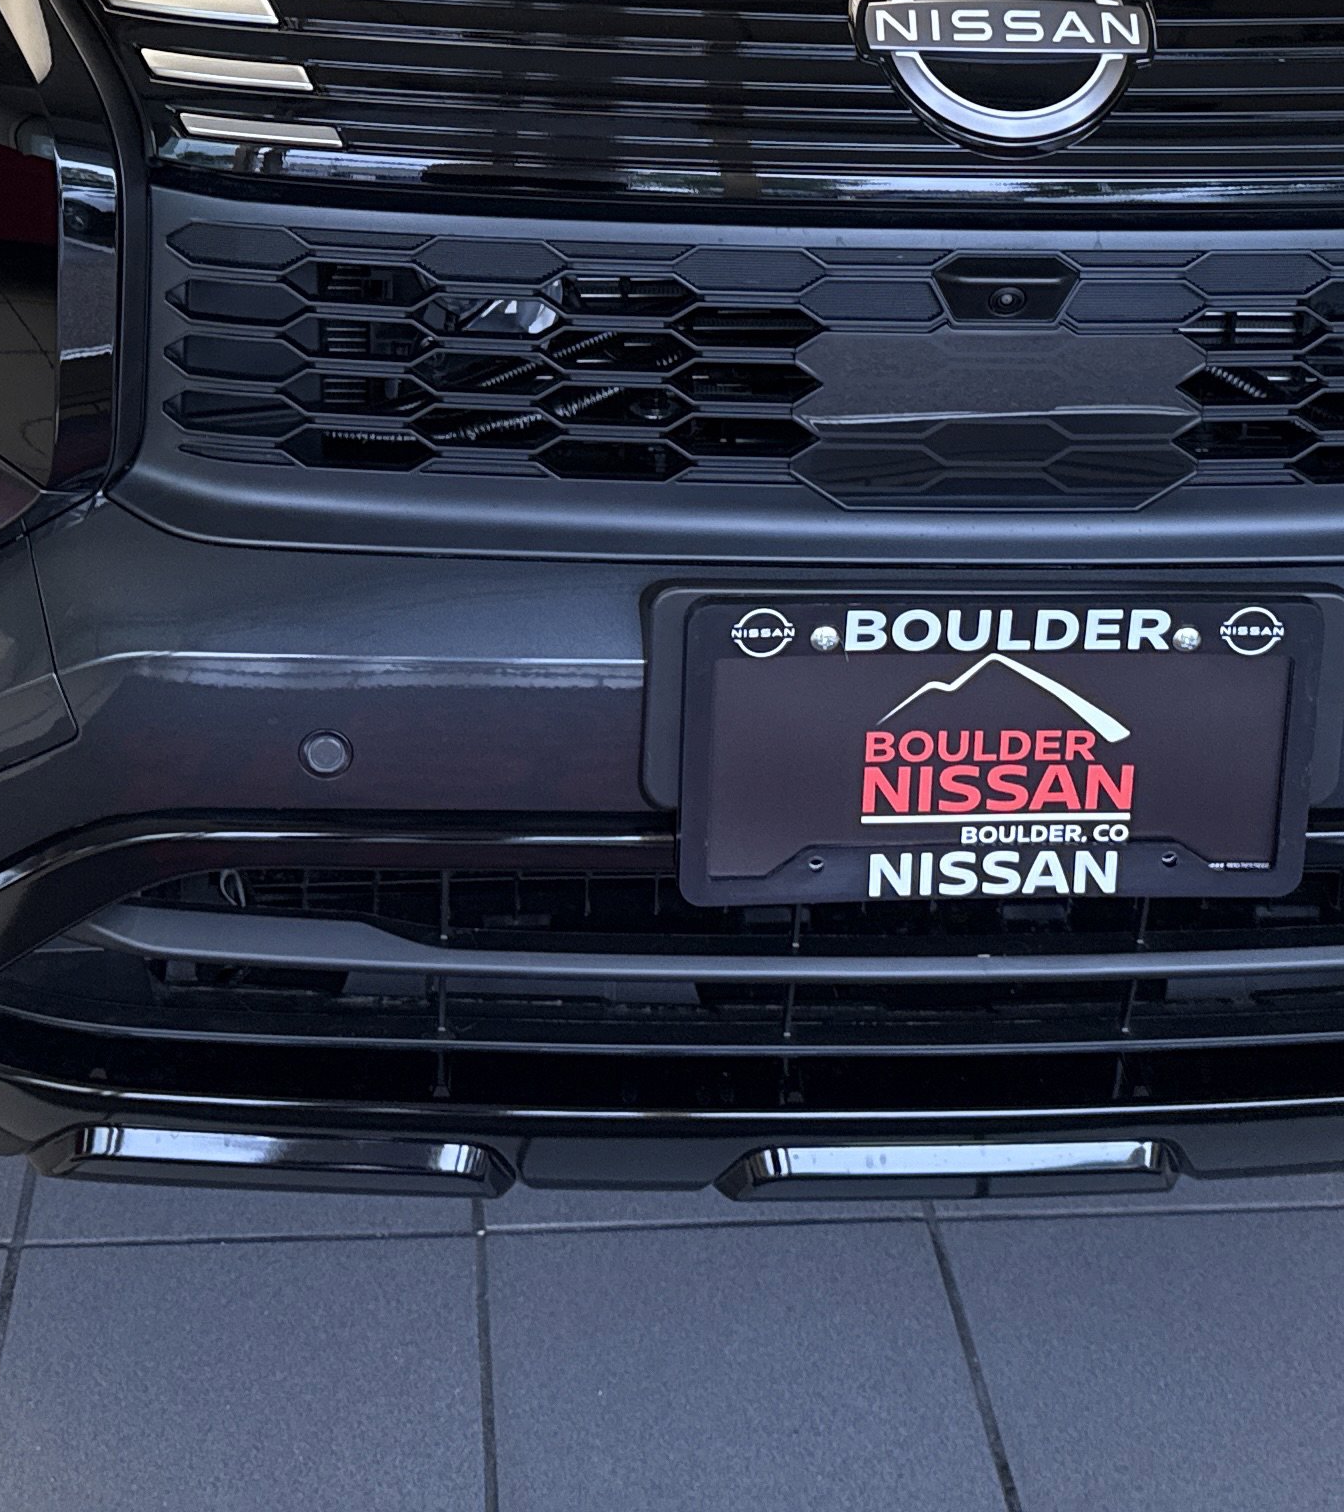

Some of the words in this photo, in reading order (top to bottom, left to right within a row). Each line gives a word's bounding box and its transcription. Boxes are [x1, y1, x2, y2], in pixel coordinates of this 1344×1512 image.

[874, 7, 1142, 46] NISSAN
[730, 627, 796, 639] NISSAN
[843, 608, 1171, 653] BOULDER
[1219, 625, 1285, 637] NISSAN
[864, 727, 1097, 763] BOULDER
[859, 763, 1136, 815] NISSAN
[1092, 823, 1130, 843] CO
[866, 849, 1119, 899] NISSAN
